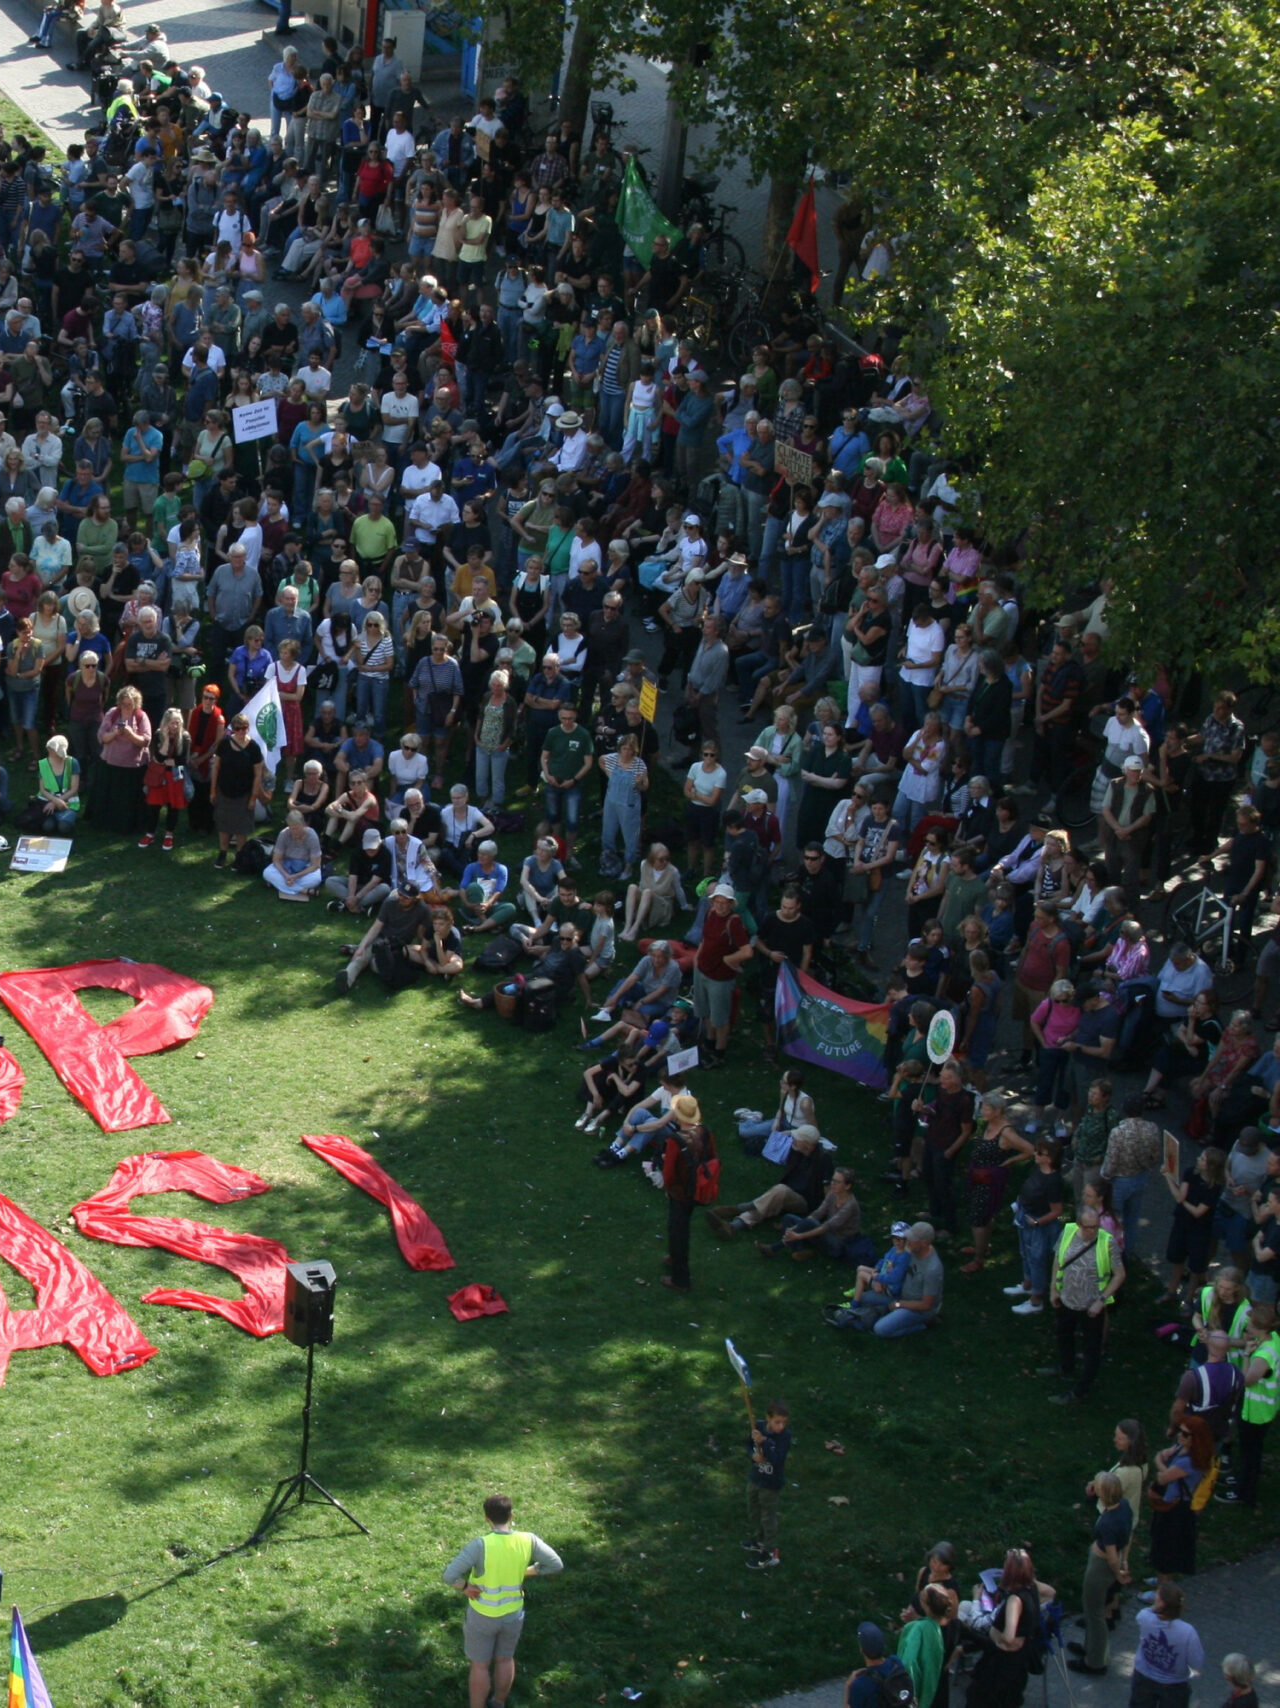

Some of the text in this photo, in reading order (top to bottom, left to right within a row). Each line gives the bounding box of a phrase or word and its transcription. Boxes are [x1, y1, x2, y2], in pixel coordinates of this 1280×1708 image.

[777, 443, 810, 466] CLIMATE
[779, 454, 810, 476] JUSTICE
[816, 1039, 863, 1057] FUTURE
